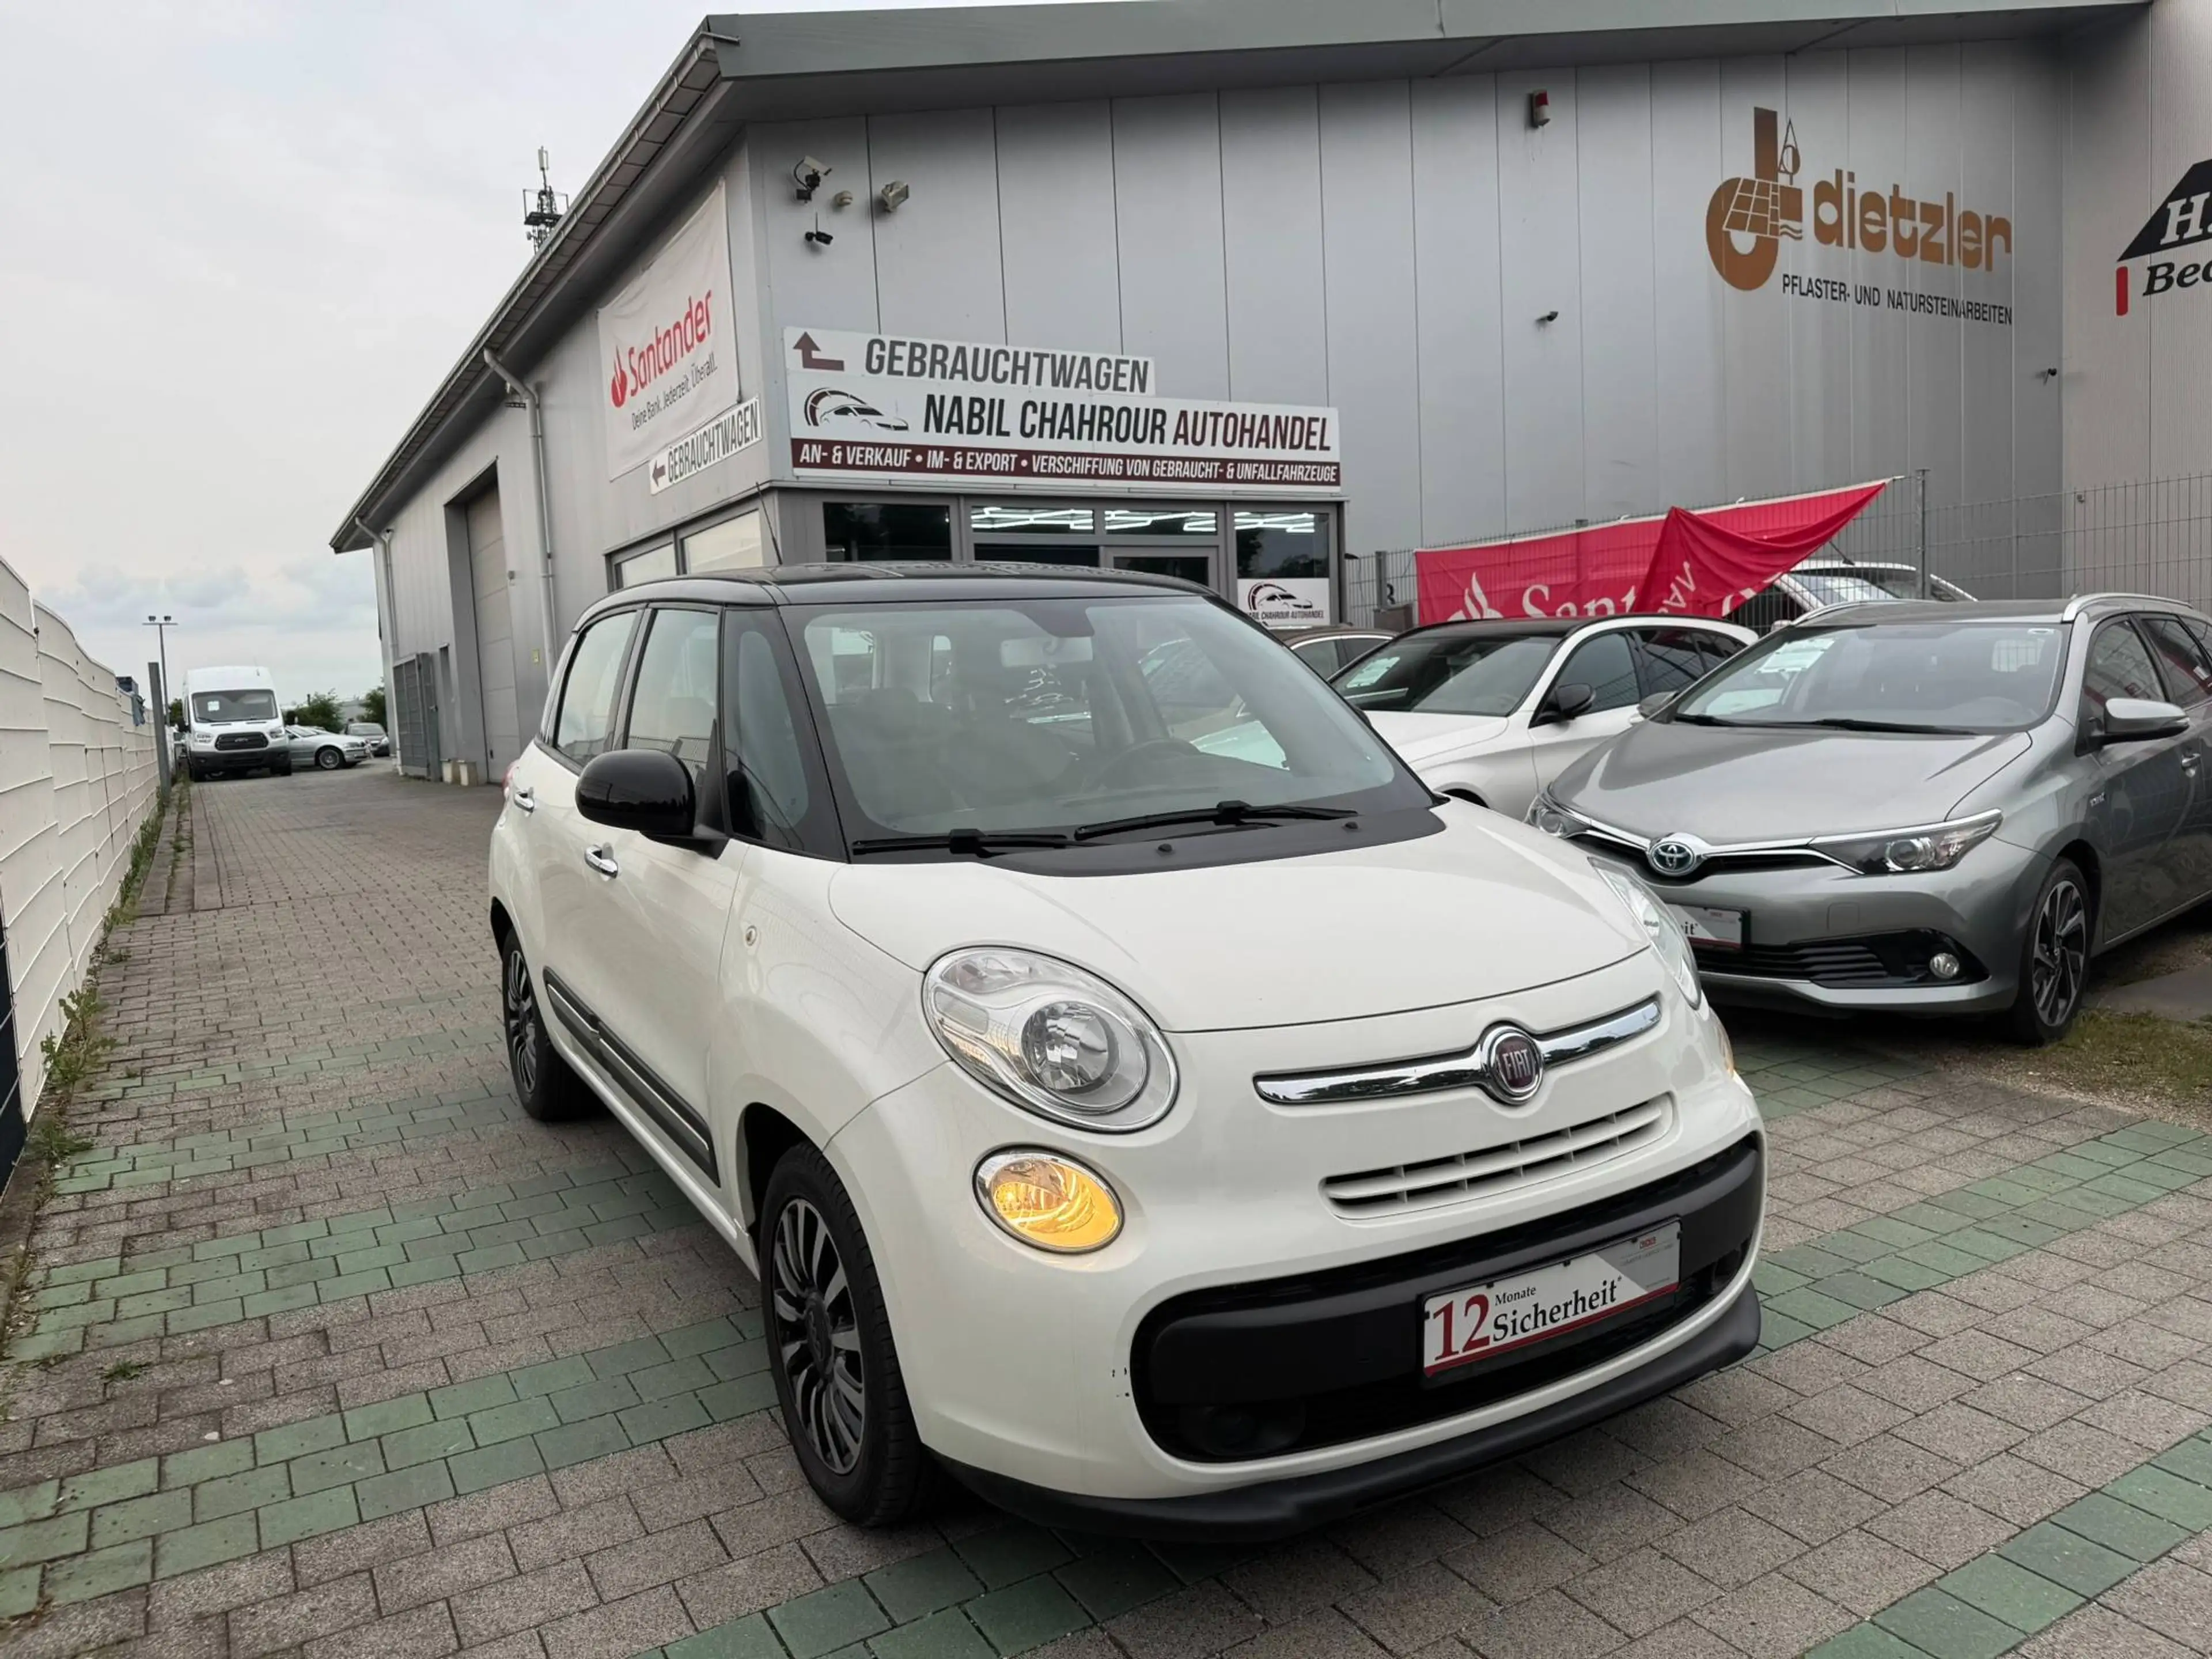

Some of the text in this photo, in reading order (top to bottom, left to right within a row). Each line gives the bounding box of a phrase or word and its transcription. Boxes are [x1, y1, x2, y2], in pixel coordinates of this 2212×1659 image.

[1813, 169, 2013, 272] dietzler
[1782, 274, 2013, 325] PFLASTER- UND NATURSTEINARBEITEN
[628, 289, 713, 397] Santander
[865, 338, 1148, 393] GEBRAUCHTWAGEN
[631, 351, 718, 431] Deine Bank. Jederzeit. Überall.
[668, 400, 759, 483] GEBRAUCHTWAGEN
[923, 393, 1331, 452] NABIL CHAHROUR AUTOHANDEL
[799, 443, 1337, 483] AN- & VERKAUF IM- & EXPORT VERSCHIFFUNG VON GEBRAUCHT- & UNFALLFAHRZEUGE
[1502, 1048, 1532, 1080] FIAT
[1495, 1285, 1536, 1306] Monate
[1433, 1293, 1491, 1361] 12
